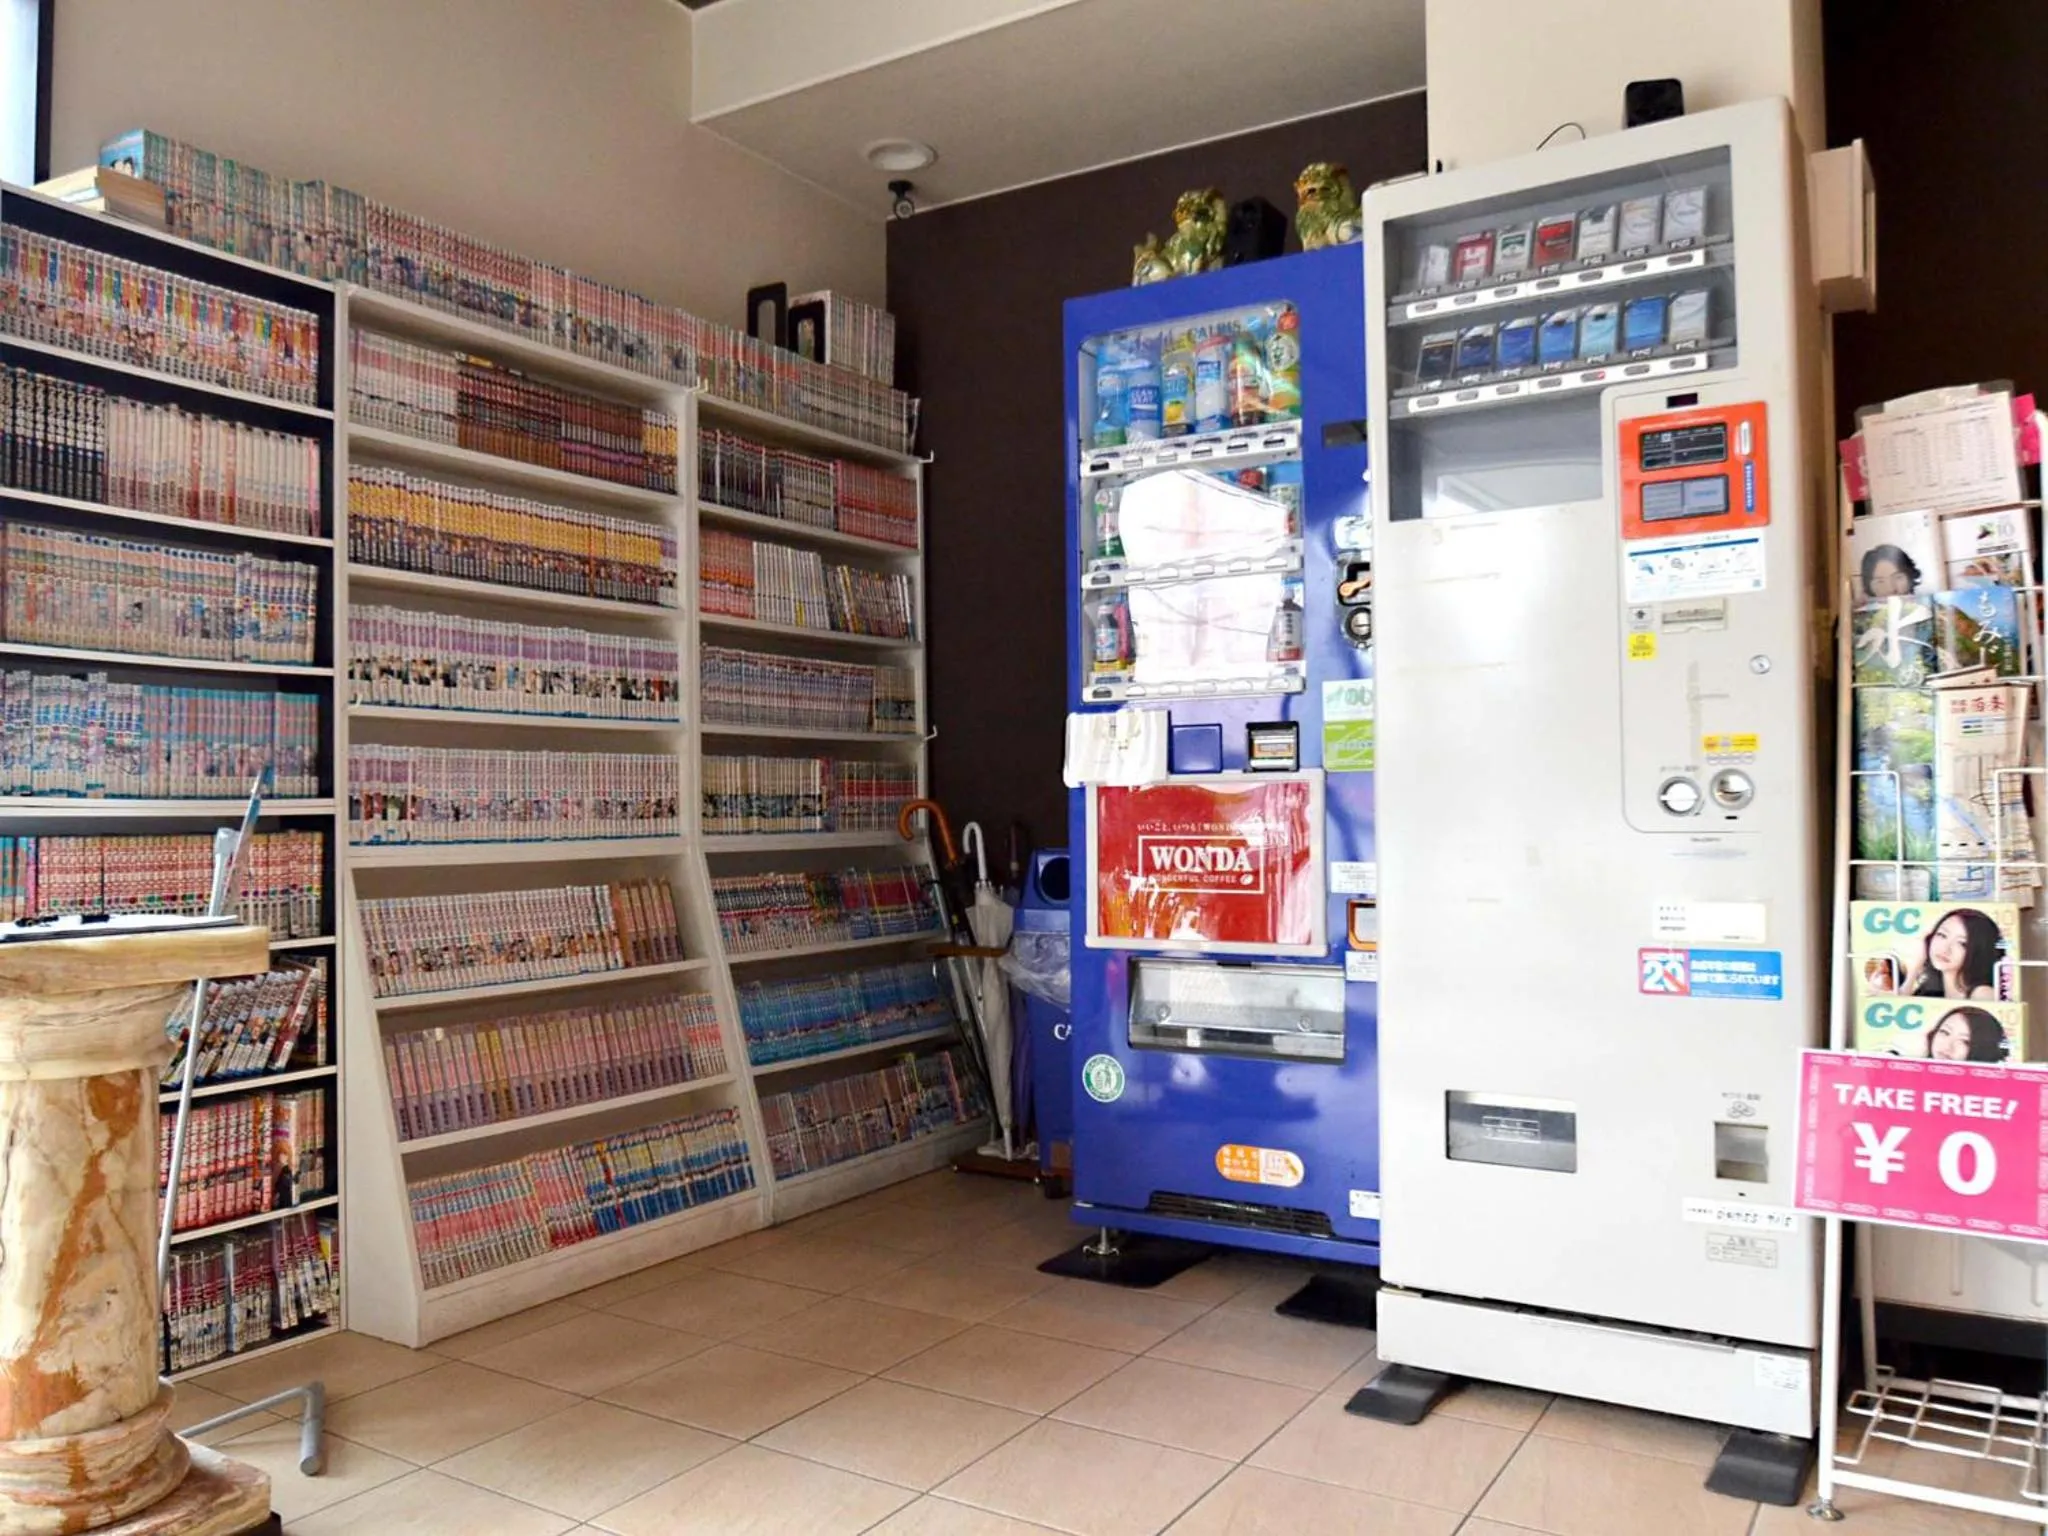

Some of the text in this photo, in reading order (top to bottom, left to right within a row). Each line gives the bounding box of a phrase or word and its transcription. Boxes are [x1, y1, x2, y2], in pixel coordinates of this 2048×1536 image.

[1148, 845, 1253, 872] WONDA
[1863, 907, 1921, 934] GC
[1865, 1002, 1924, 1030] GC
[1833, 1083, 2019, 1121] TAKE FREE!
[1852, 1121, 1997, 1196] ¥ 0
